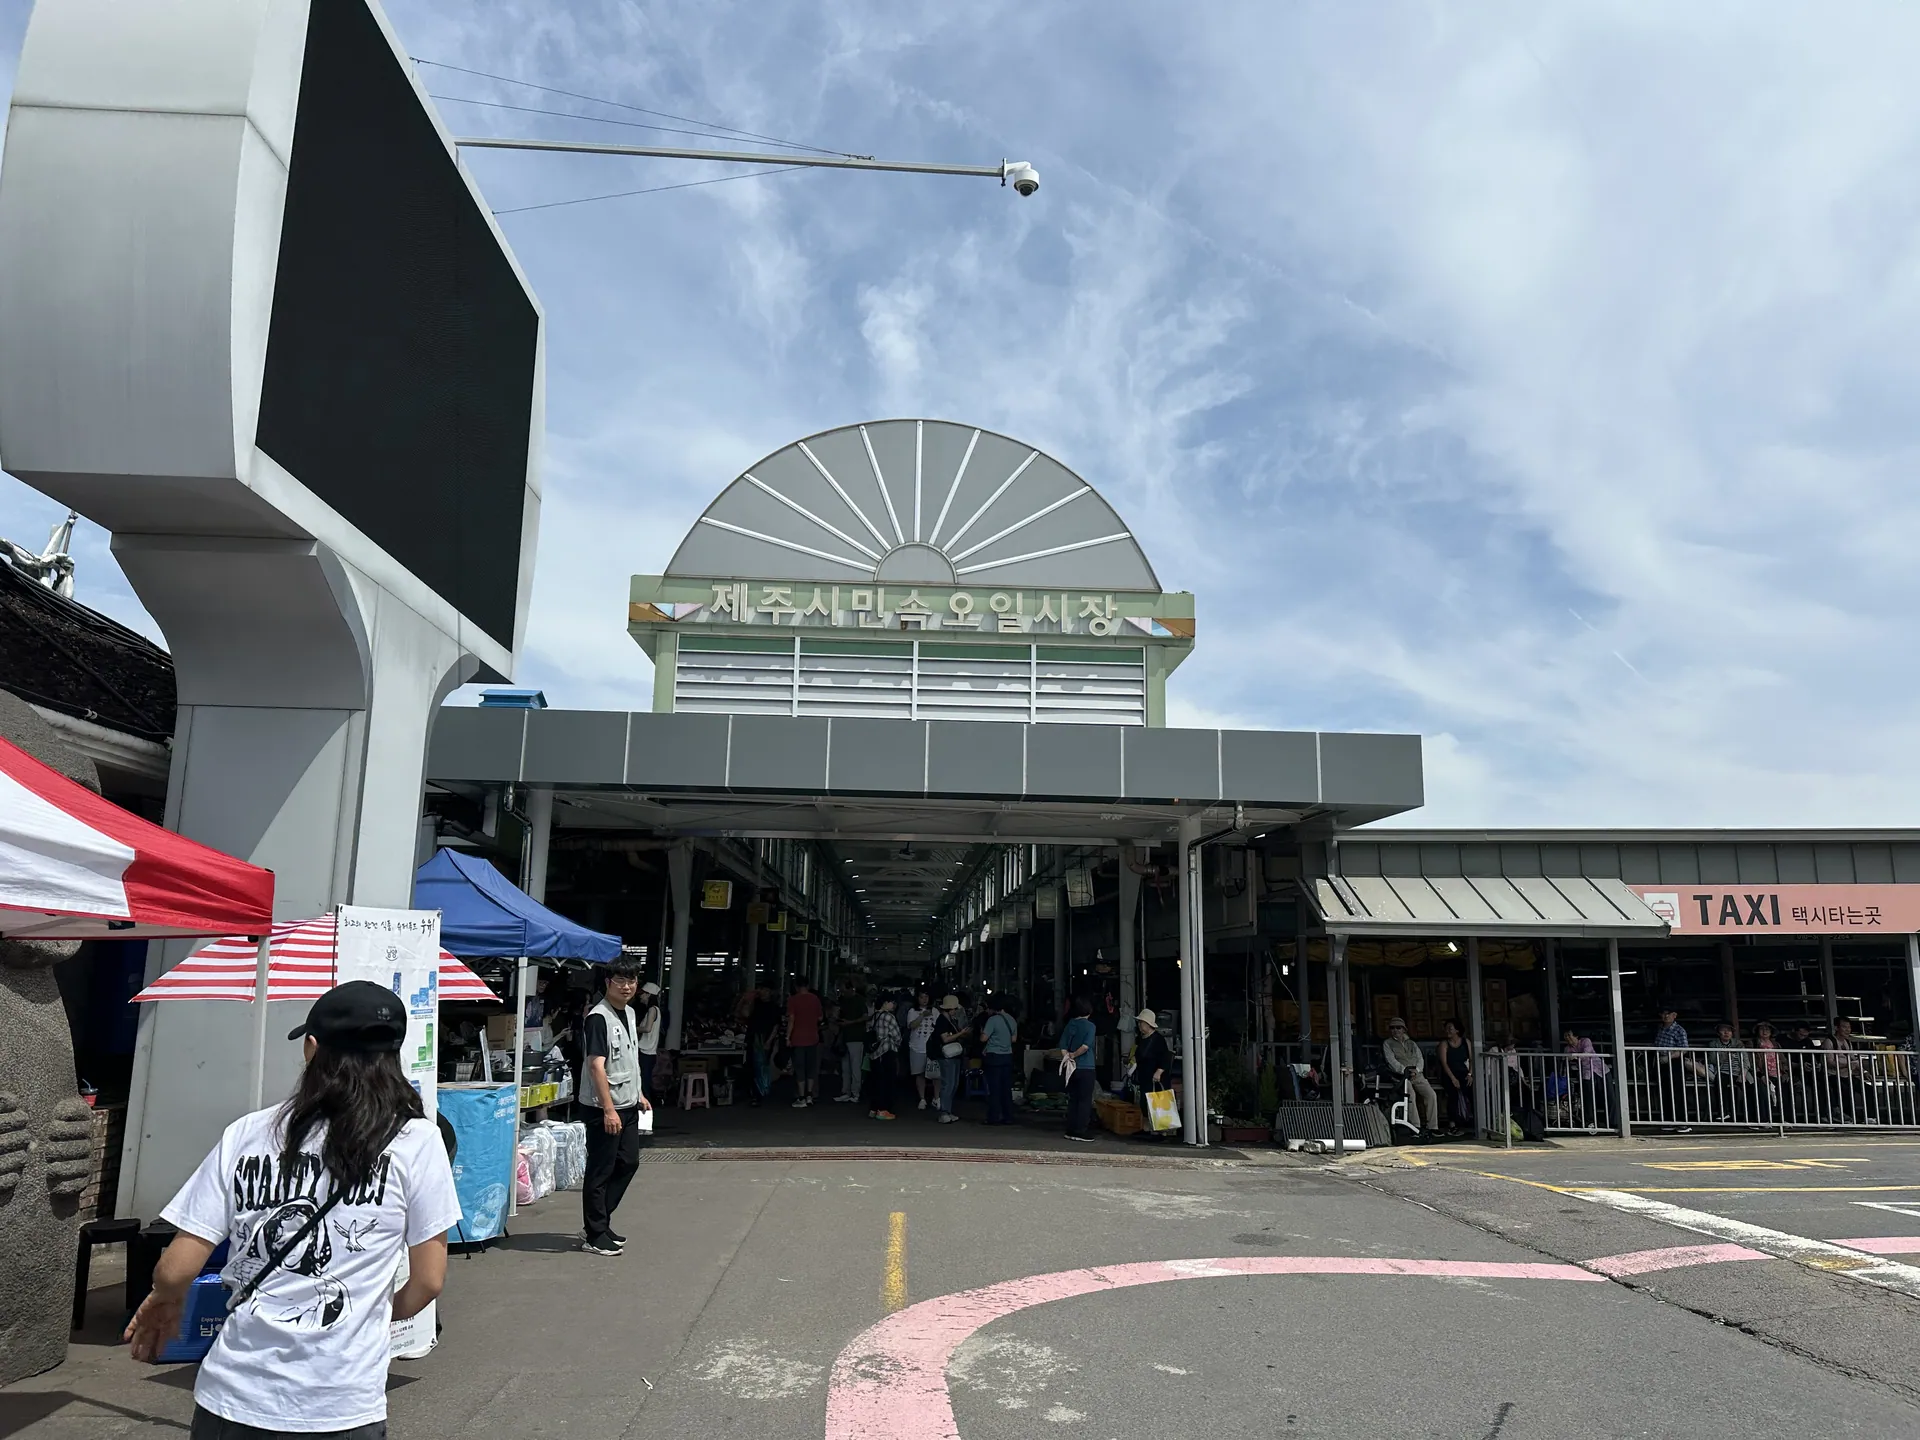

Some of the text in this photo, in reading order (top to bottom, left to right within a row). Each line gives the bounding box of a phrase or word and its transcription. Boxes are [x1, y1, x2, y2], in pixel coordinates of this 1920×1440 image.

[709, 582, 1118, 637] 제주시민속오일시장
[1693, 894, 1781, 926] TAXI
[1792, 905, 1882, 926] 택시타는곳
[344, 916, 361, 927] 최고의
[420, 918, 435, 937] 우유!
